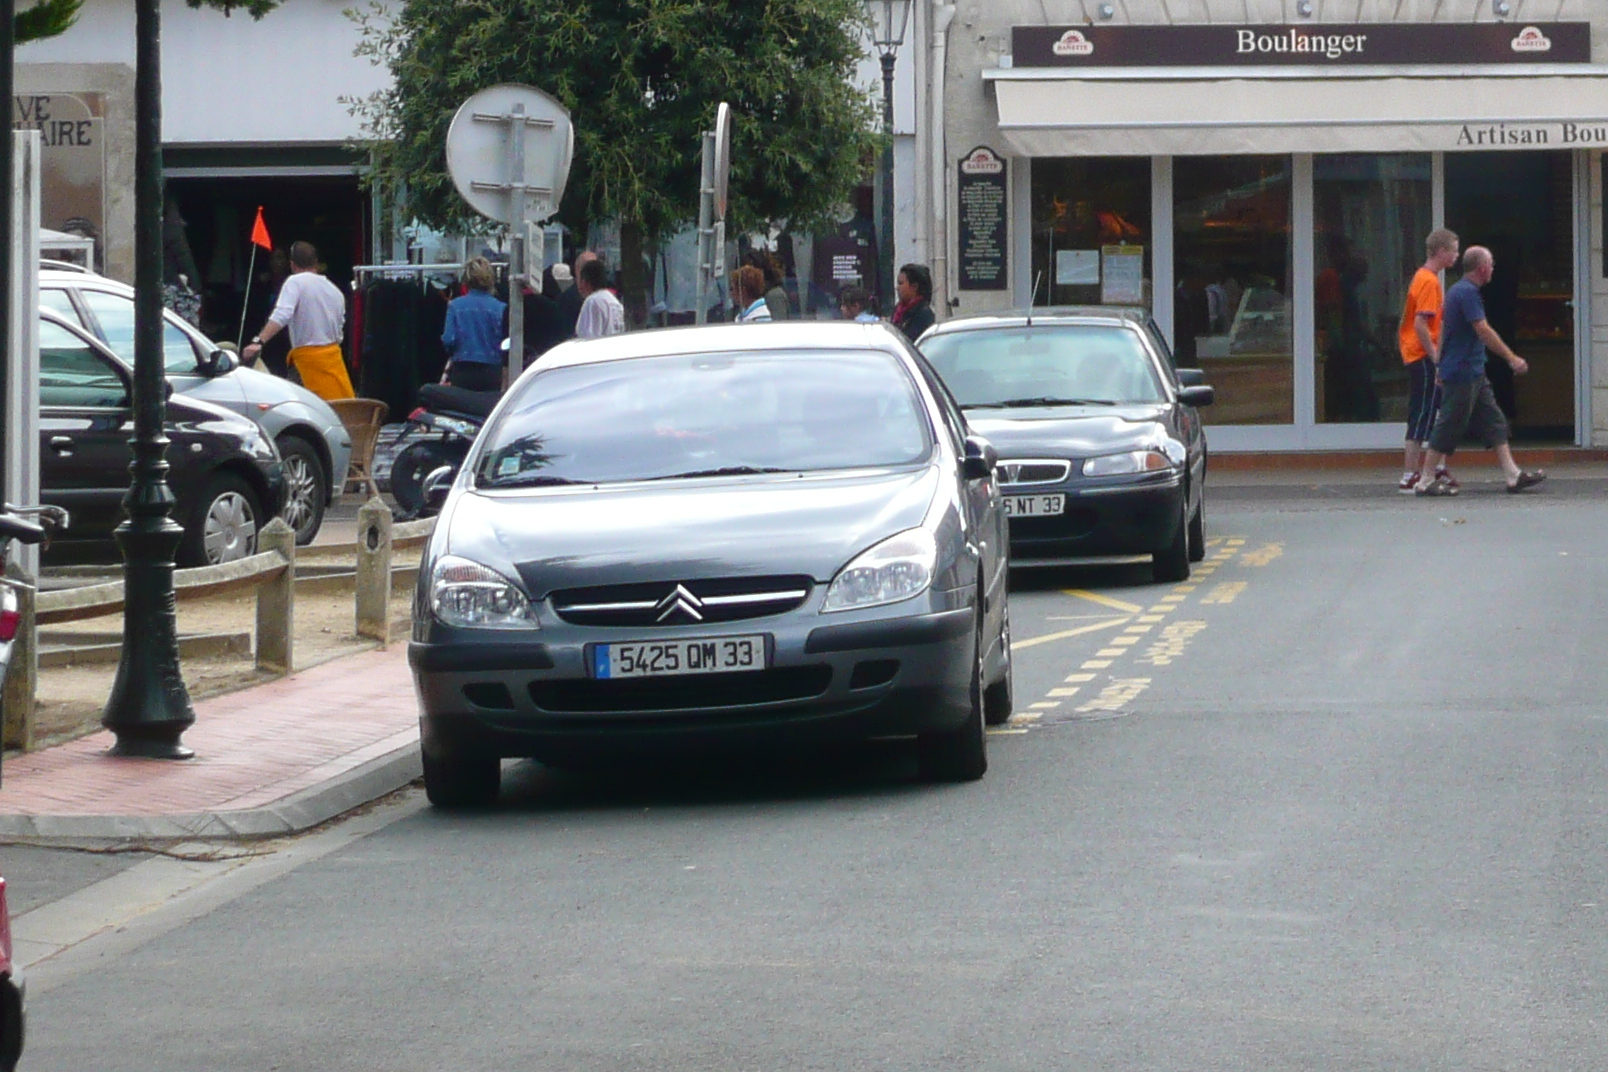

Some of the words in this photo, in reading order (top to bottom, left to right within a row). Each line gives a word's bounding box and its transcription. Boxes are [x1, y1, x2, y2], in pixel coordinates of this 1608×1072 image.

[1236, 28, 1367, 59] Boulanger
[1457, 125, 1548, 145] Artisan
[1017, 498, 1035, 514] NT
[1043, 497, 1061, 513] 33
[620, 644, 679, 674] 5425
[687, 642, 717, 669] QM
[723, 641, 753, 666] 33
